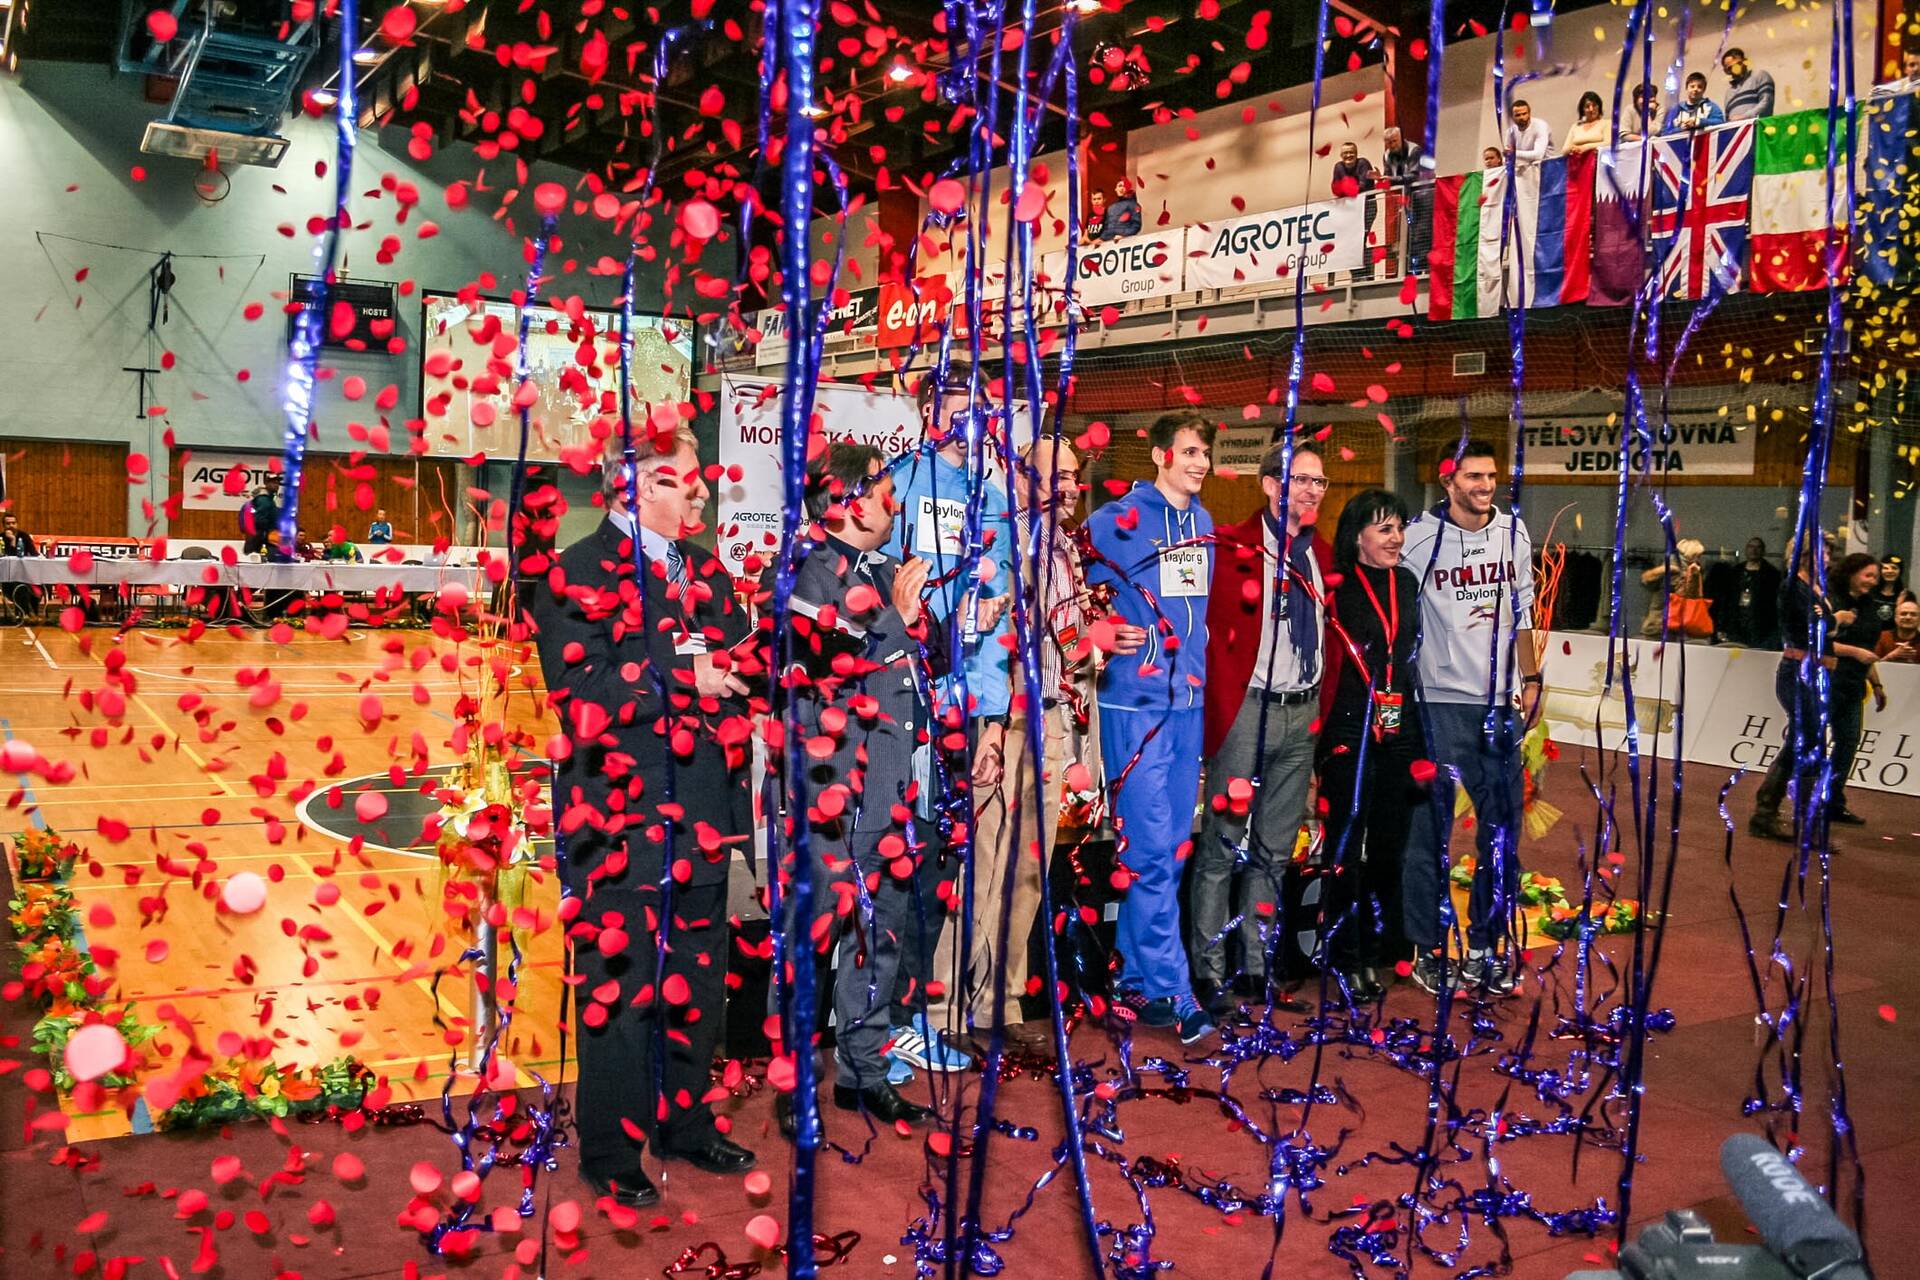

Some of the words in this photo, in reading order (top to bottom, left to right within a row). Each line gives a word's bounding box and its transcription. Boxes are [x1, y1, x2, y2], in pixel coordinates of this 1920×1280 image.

[1210, 210, 1336, 258] AGROTEC
[1286, 251, 1328, 271] Group
[1121, 279, 1155, 294] Group
[362, 308, 388, 317] HOSTE
[731, 512, 779, 523] AGROTEC
